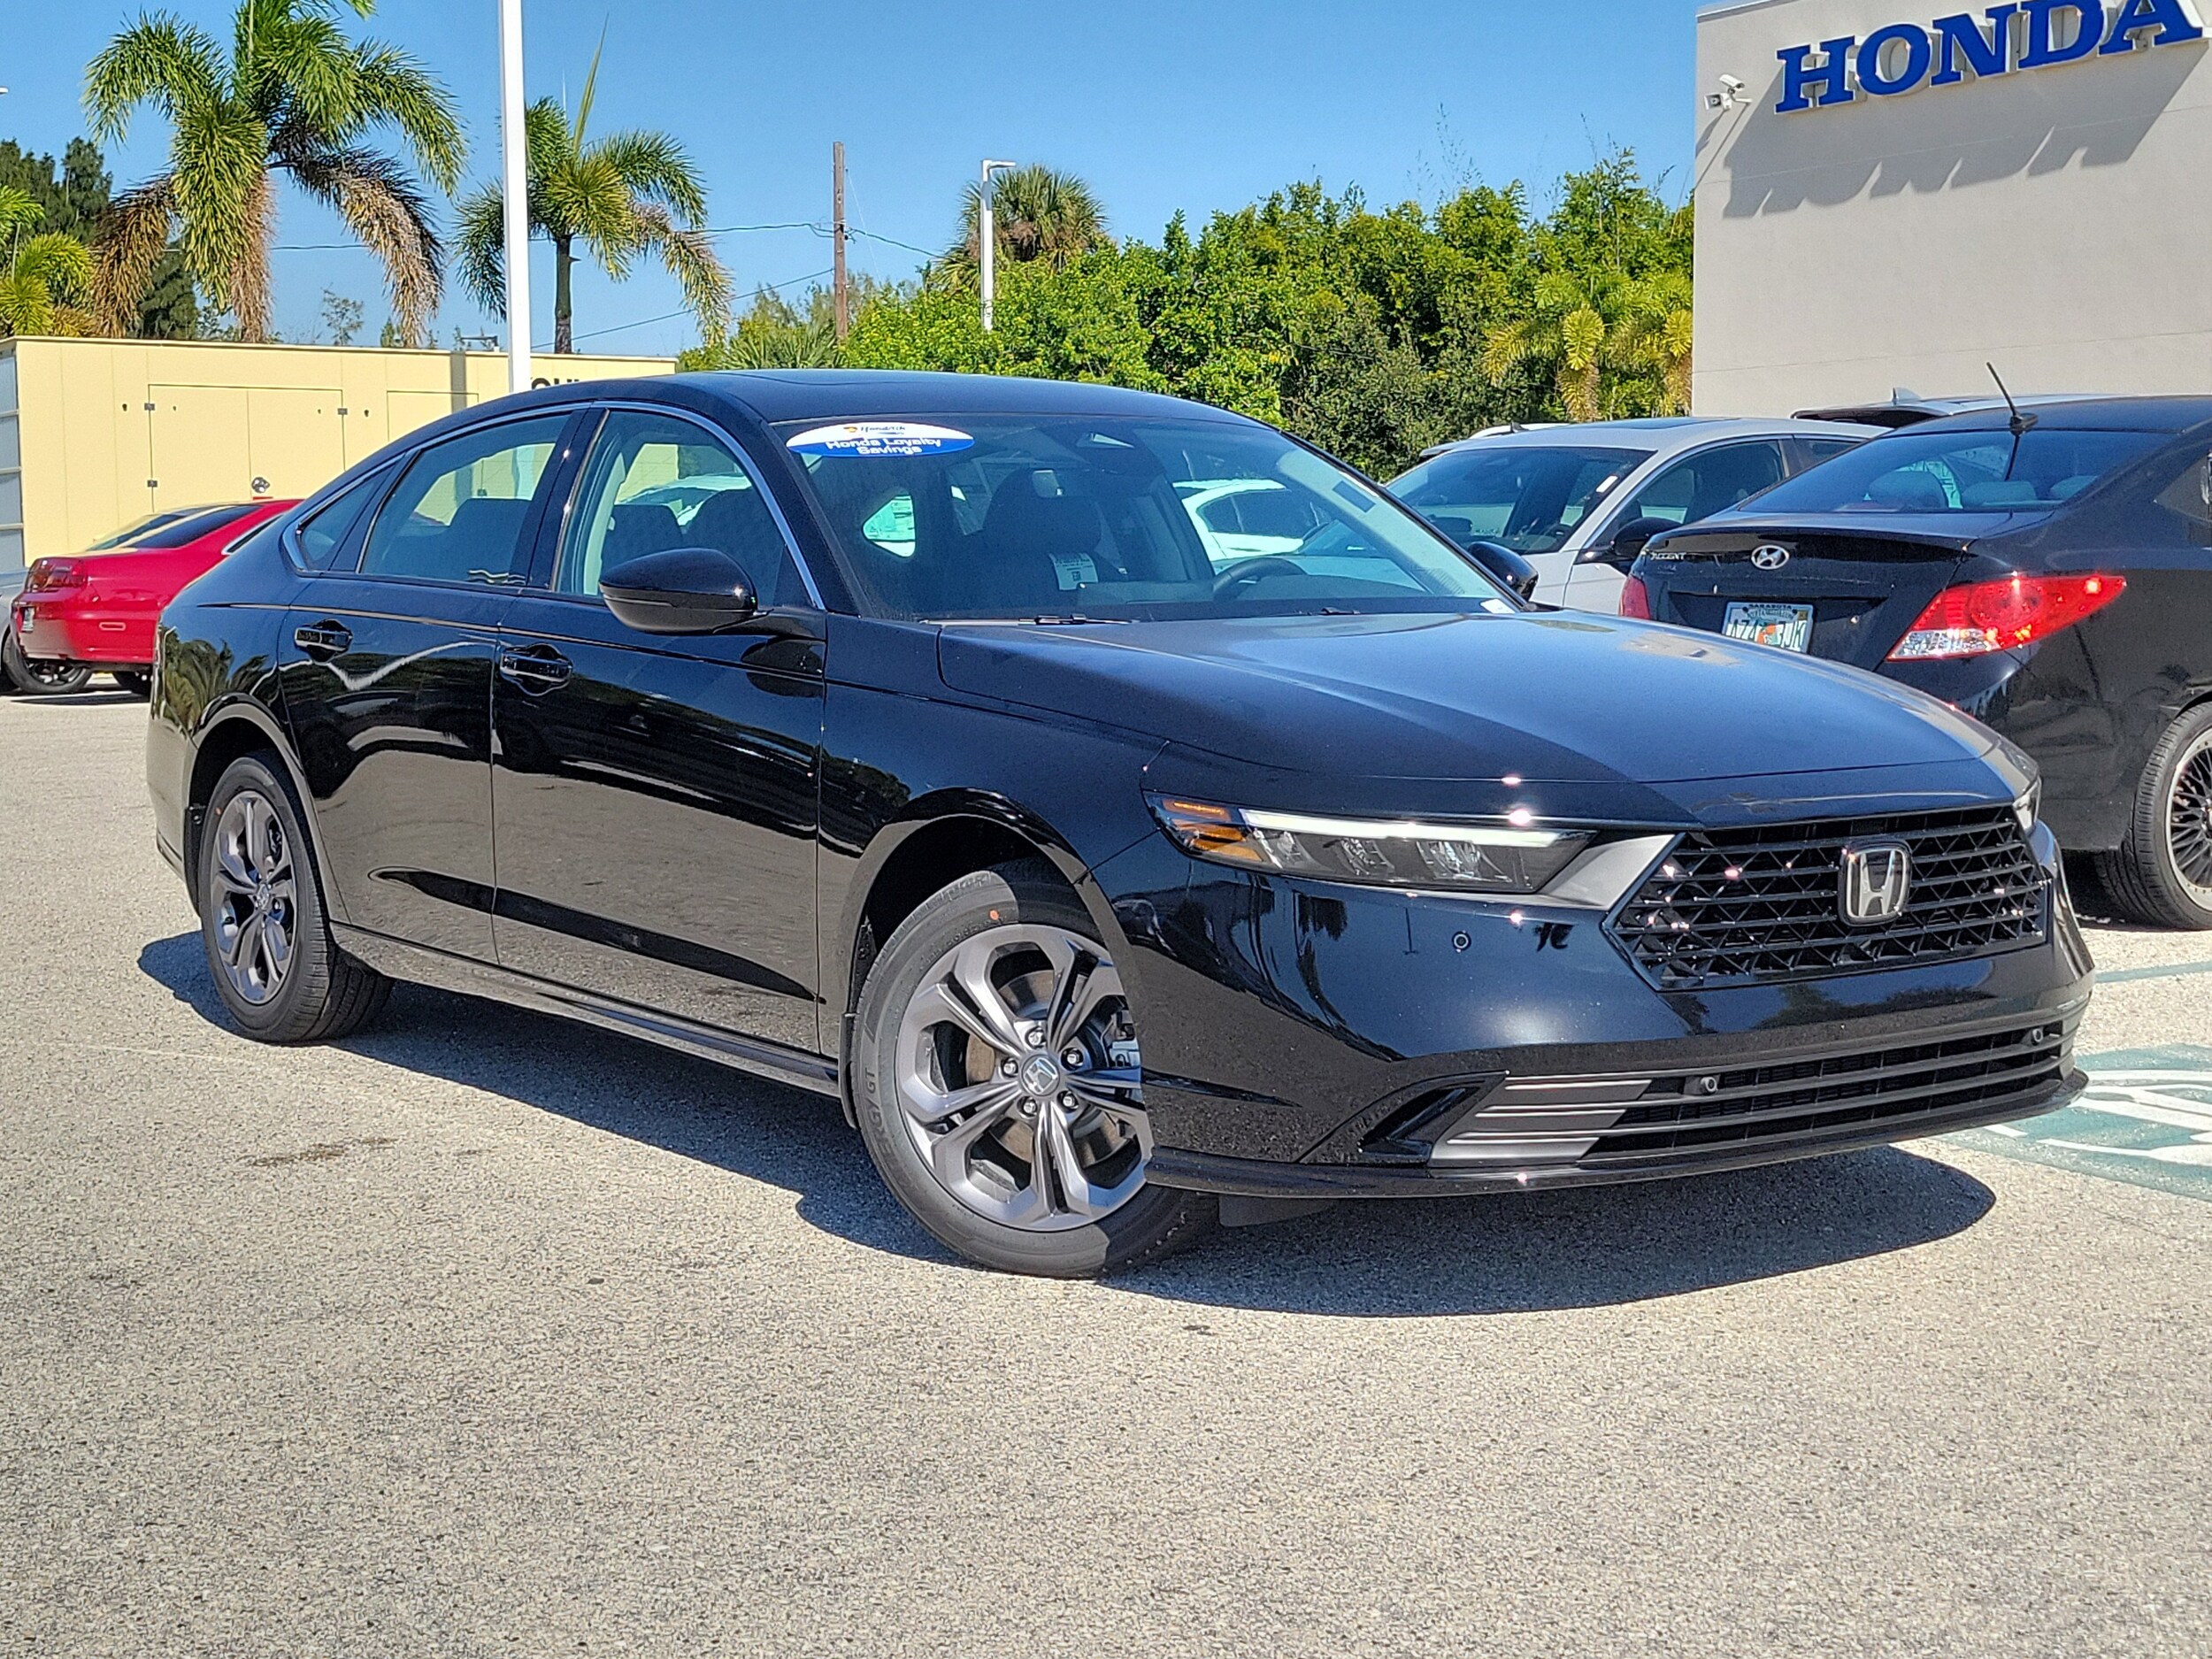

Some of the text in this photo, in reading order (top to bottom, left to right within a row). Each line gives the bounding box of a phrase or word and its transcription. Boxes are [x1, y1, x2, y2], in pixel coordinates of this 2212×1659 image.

[1774, 0, 2203, 113] HONDA
[826, 438, 941, 449] Honda Loyalty
[856, 445, 923, 455] Savings
